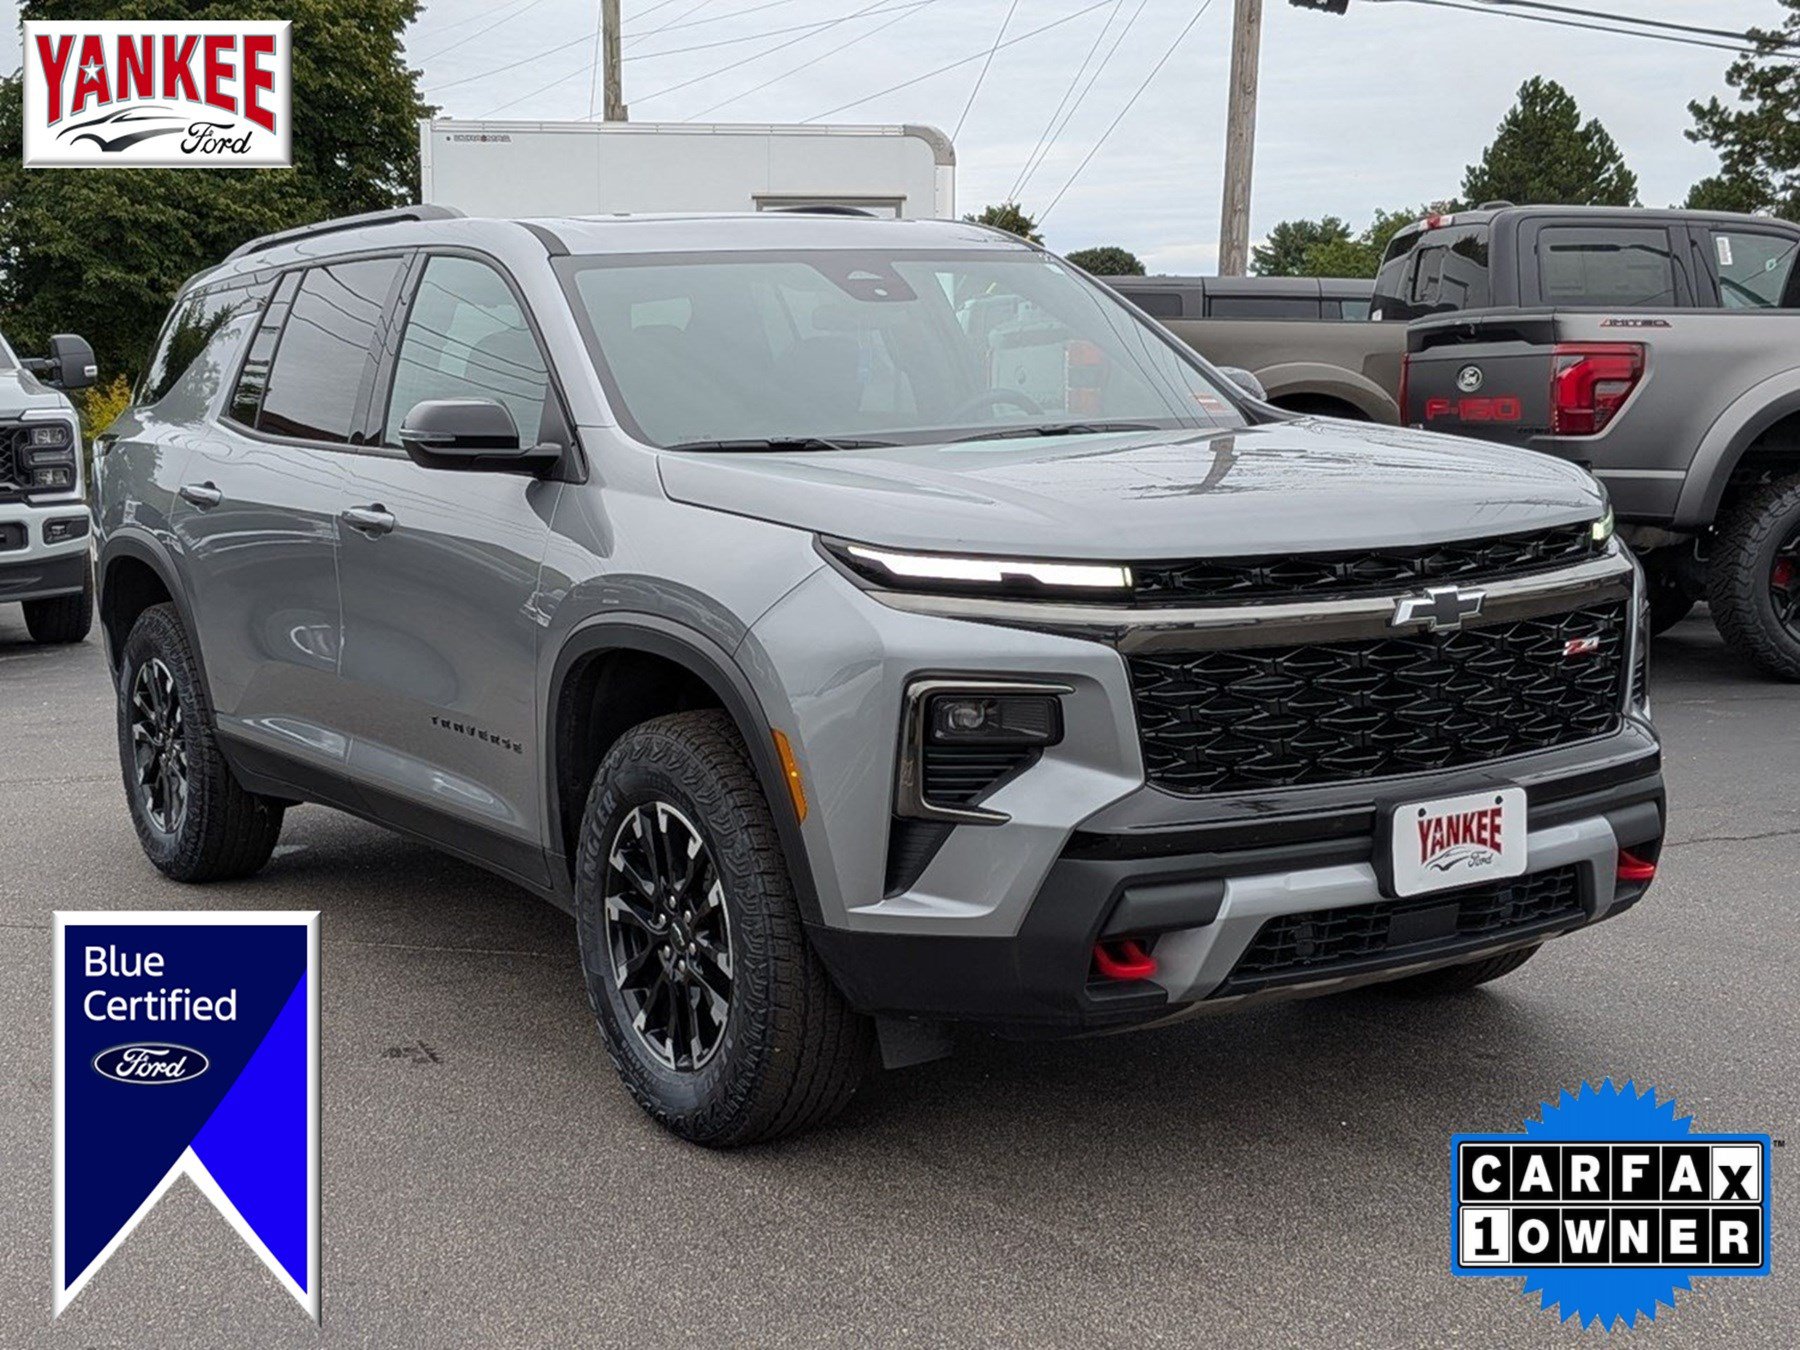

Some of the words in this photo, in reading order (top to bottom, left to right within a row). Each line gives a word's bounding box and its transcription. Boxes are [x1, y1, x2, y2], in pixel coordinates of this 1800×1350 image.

[1425, 397, 1521, 421] F-150
[430, 715, 523, 755] TRAVERSE
[1417, 806, 1503, 866] YANKEE
[1467, 850, 1494, 868] Ford
